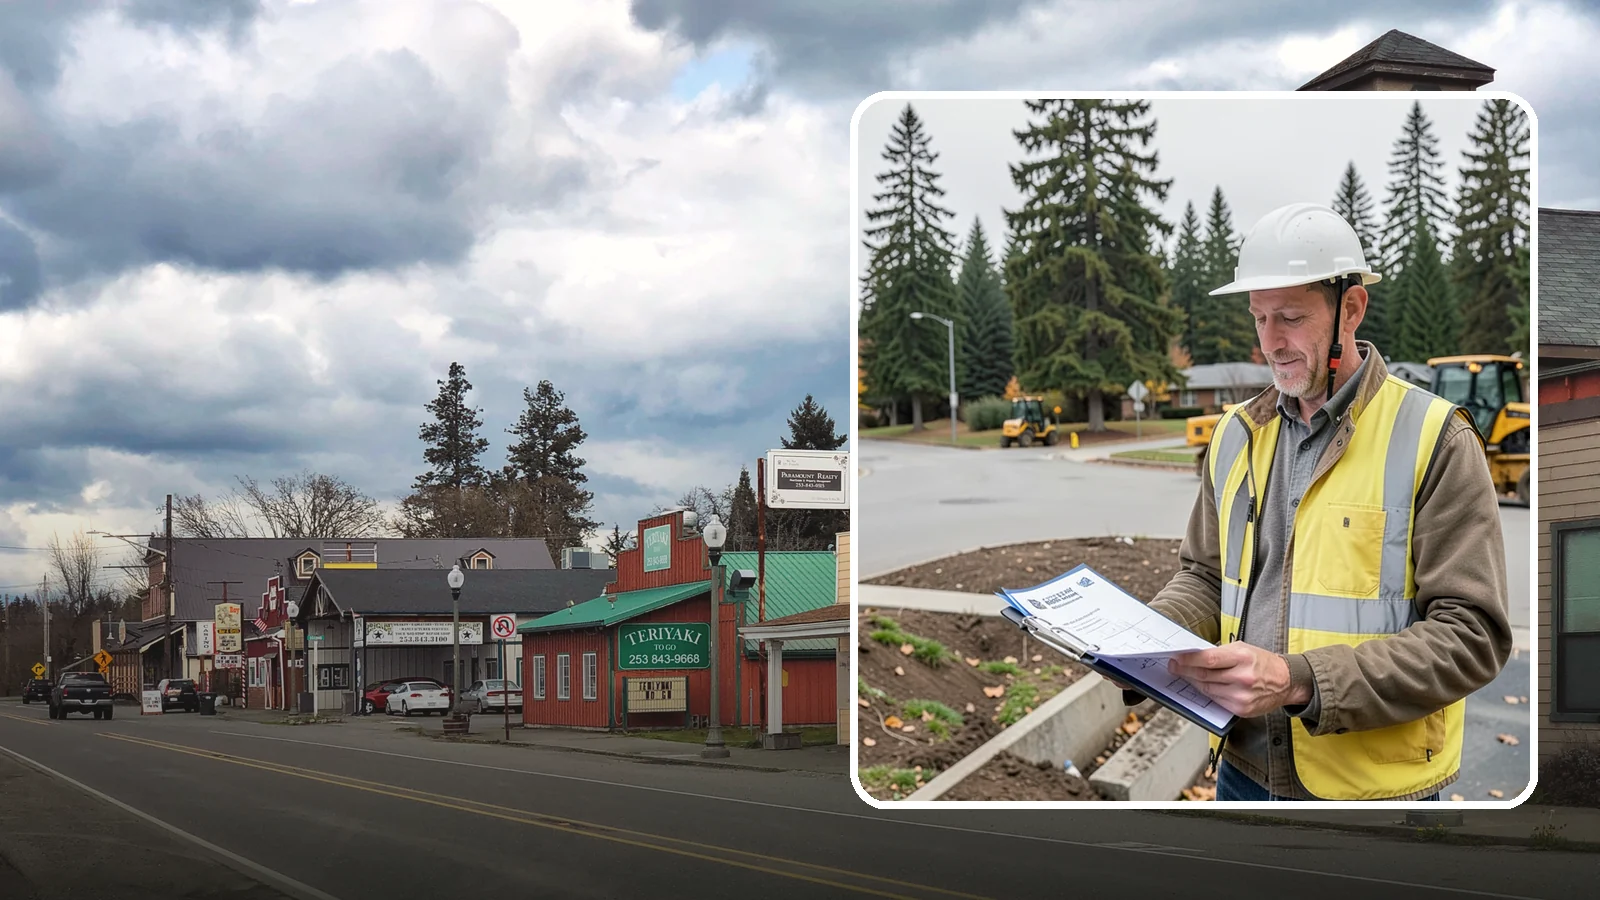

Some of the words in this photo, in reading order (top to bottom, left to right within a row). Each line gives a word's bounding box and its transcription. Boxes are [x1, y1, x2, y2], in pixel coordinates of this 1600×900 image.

[624, 628, 702, 646] TERIYAKI
[629, 654, 648, 664] 253
[652, 654, 700, 664] 843-9668
[639, 681, 672, 691] TERIYAKI
